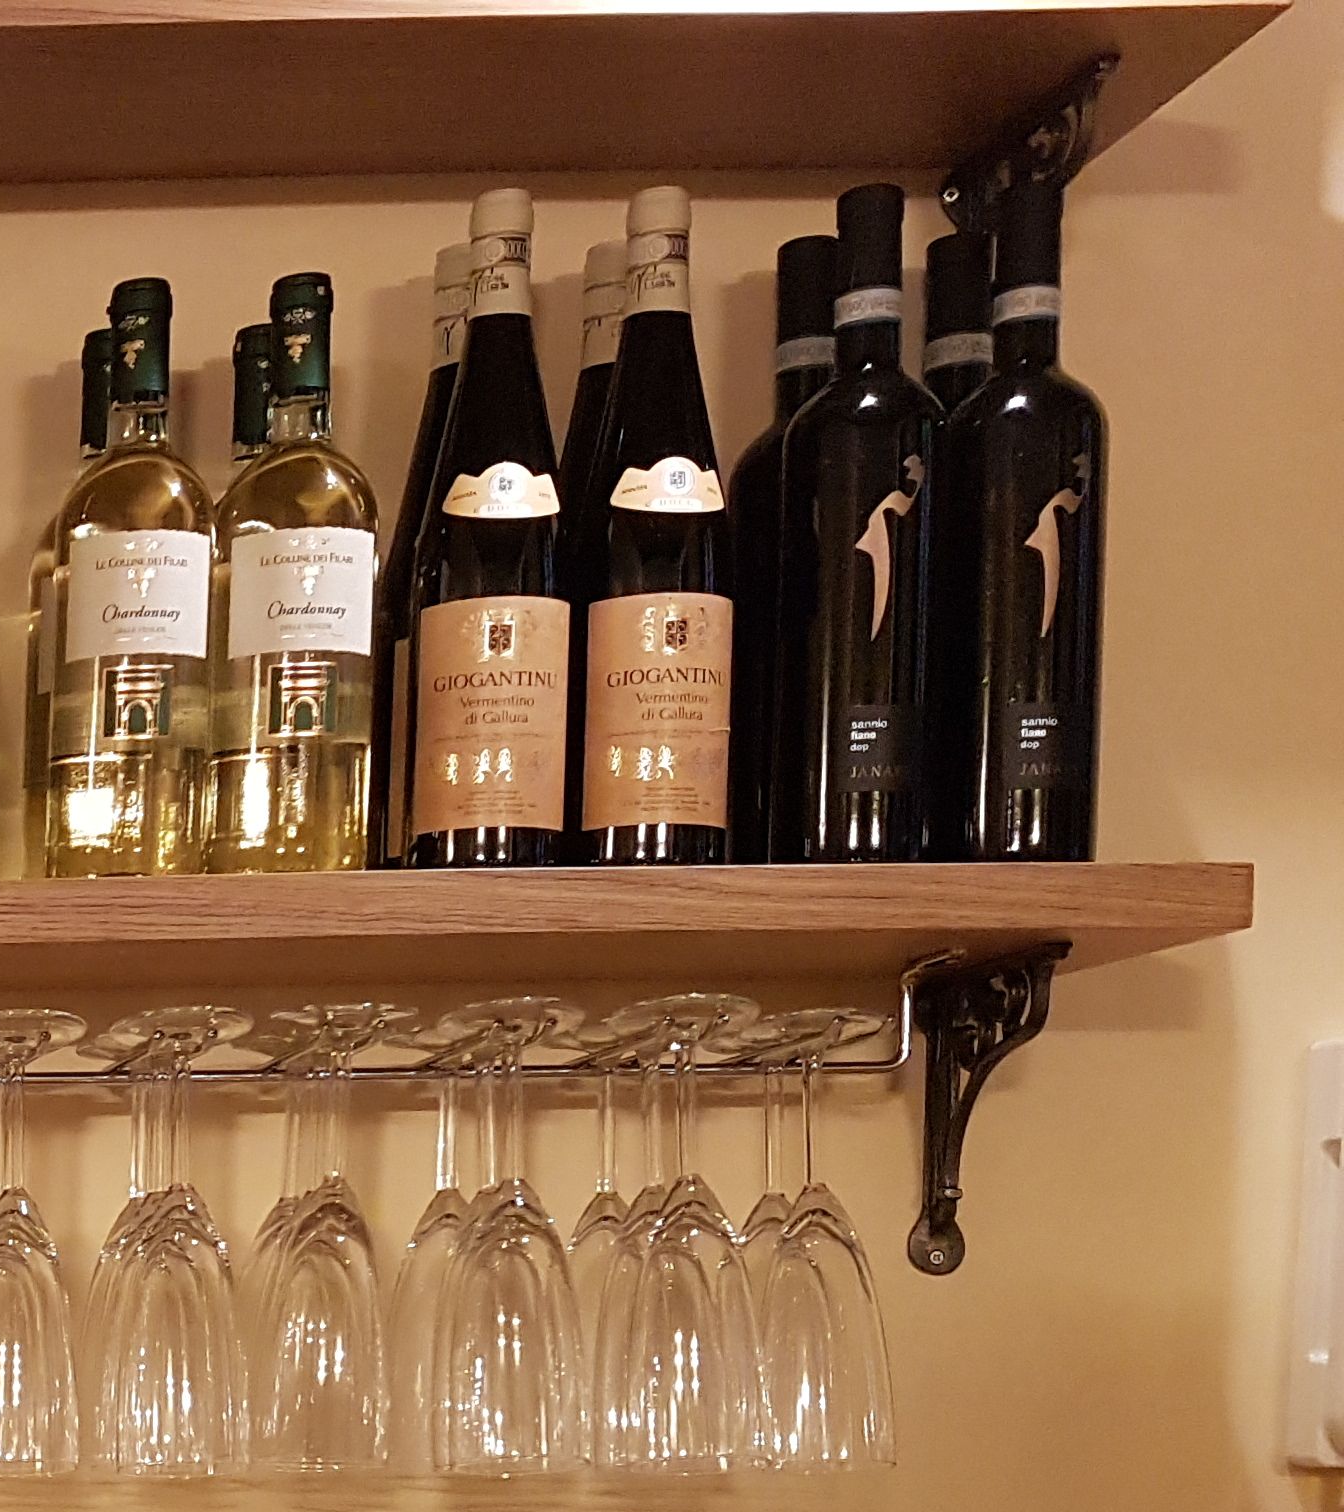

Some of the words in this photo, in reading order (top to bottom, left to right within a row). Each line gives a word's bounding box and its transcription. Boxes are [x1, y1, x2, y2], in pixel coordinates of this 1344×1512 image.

[102, 603, 181, 624] Chardonnay
[267, 600, 347, 620] Chardonnay
[433, 670, 558, 693] GIOGANTINU
[607, 666, 727, 688] GIOGANTINU
[460, 695, 535, 708] Vermentino
[636, 692, 709, 705] Vermentino
[465, 711, 478, 725] di
[482, 711, 529, 724] Gallura
[641, 708, 655, 721] di
[659, 706, 703, 721] Gallura
[1020, 740, 1041, 750] dop
